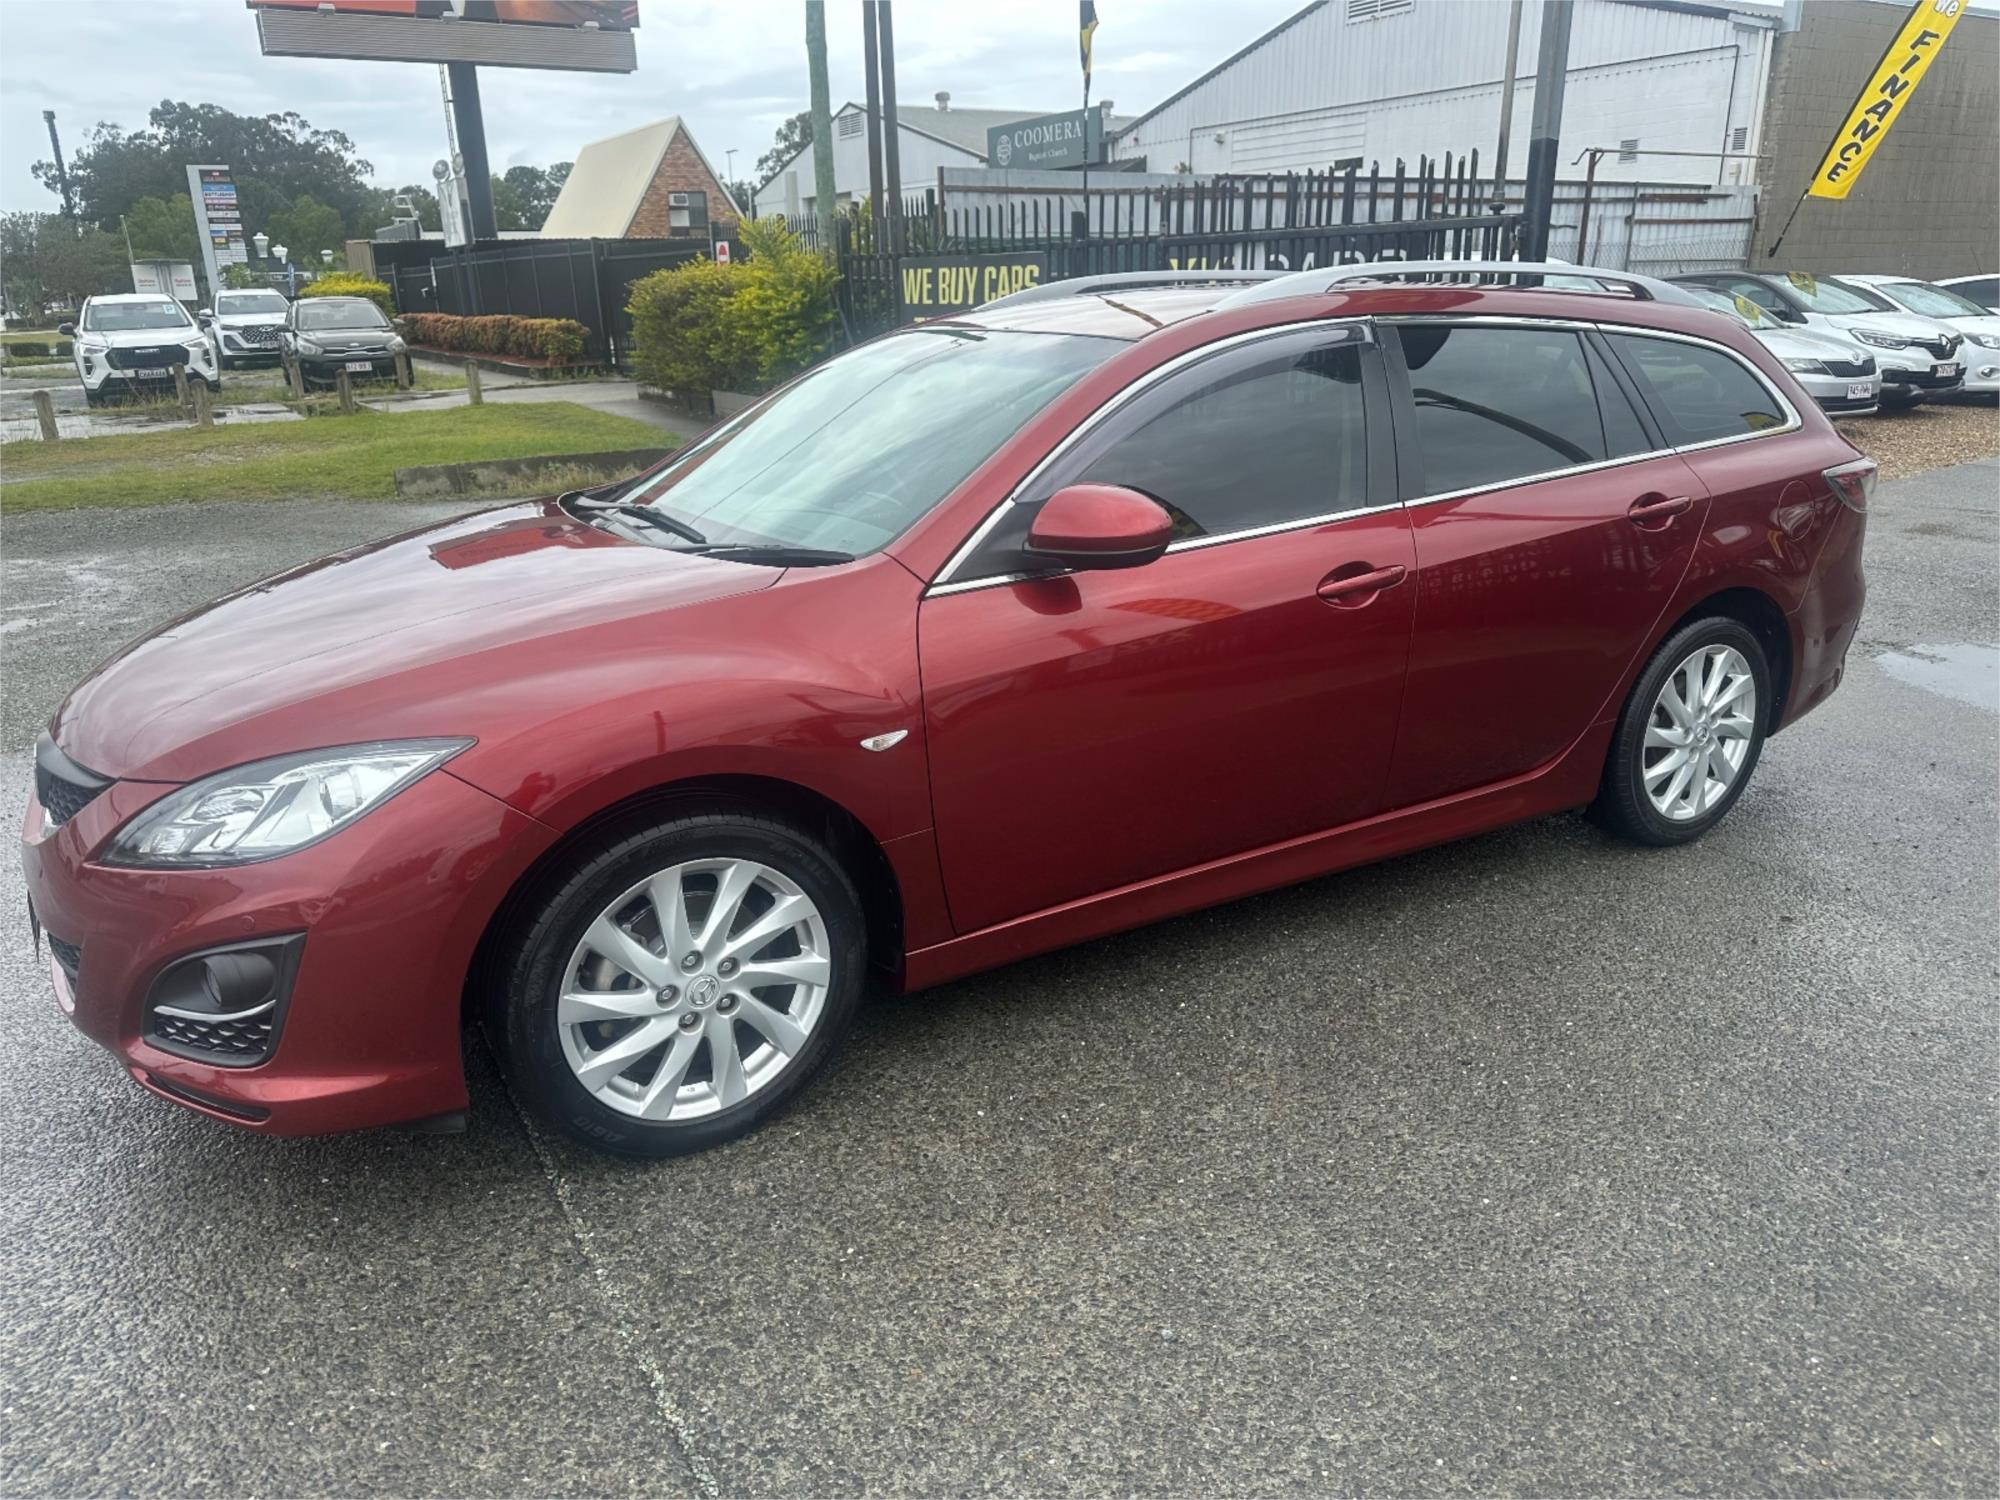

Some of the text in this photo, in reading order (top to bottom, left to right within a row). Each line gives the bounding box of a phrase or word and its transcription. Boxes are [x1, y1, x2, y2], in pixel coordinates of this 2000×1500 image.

[1827, 30, 1940, 183] FINANCE
[1014, 119, 1082, 148] COOMERA
[902, 264, 1040, 305] WE BUY CARS
